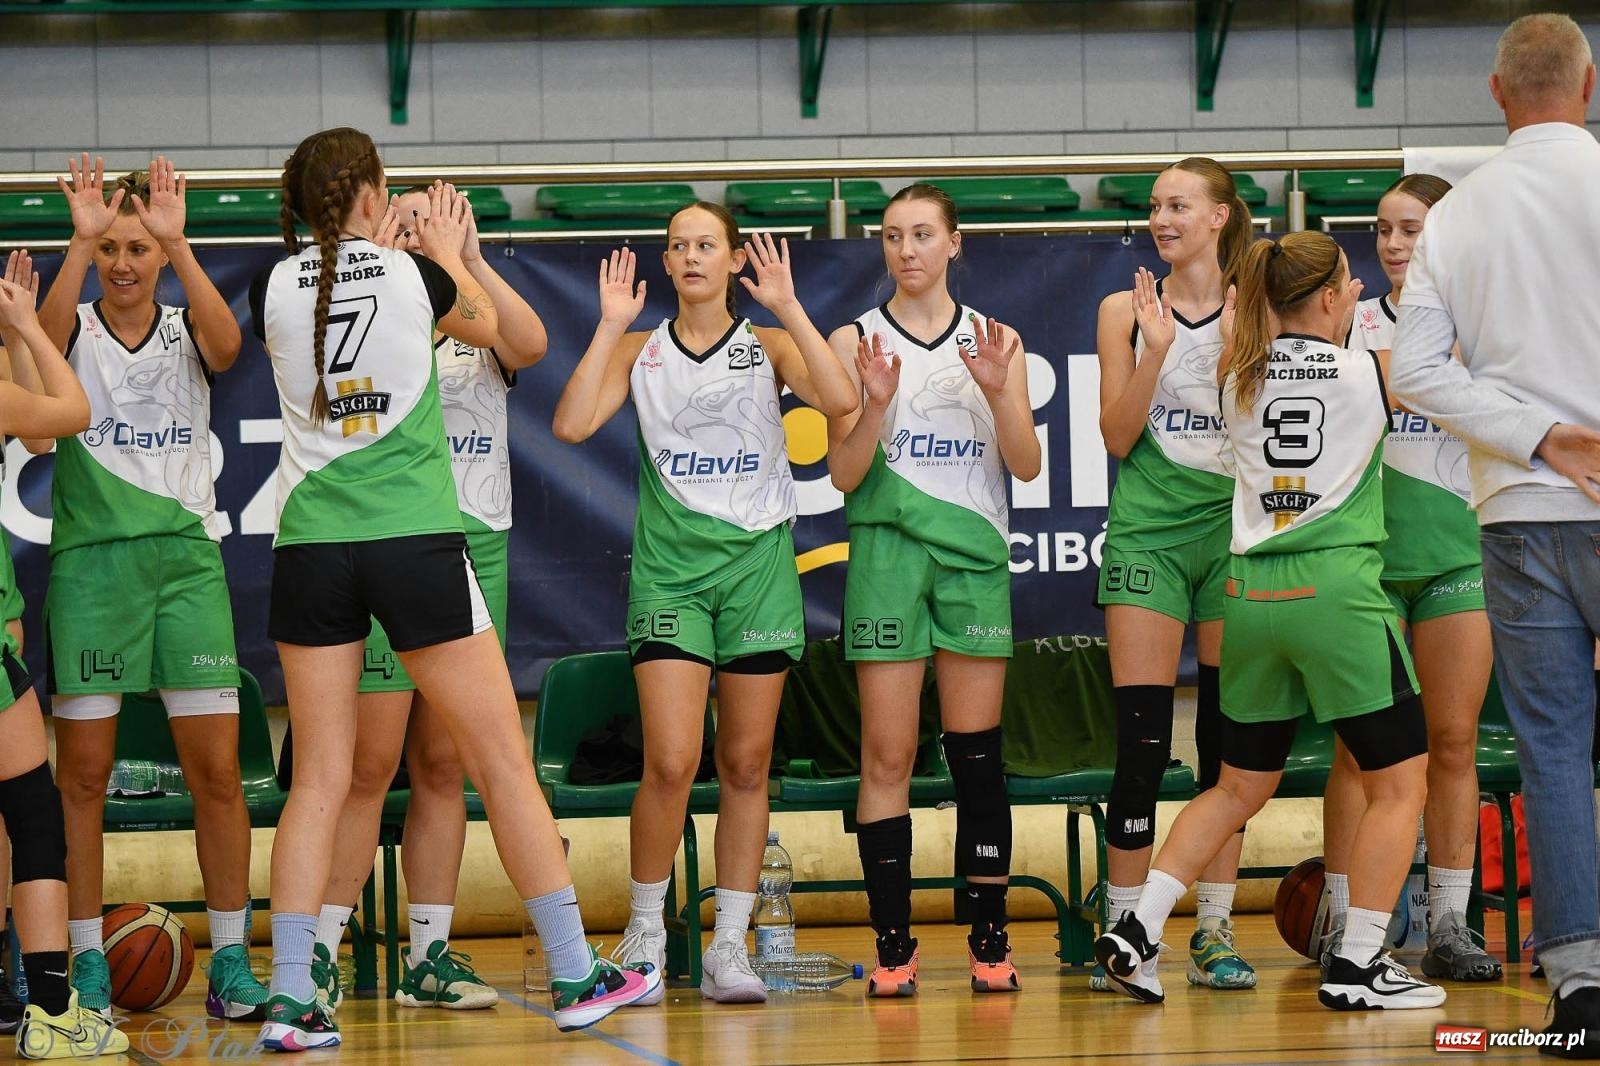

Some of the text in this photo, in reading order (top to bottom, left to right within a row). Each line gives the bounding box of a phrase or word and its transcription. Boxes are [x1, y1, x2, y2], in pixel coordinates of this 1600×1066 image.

[300, 252, 379, 272] RK AZS
[298, 265, 385, 288] RAIBÓRZ
[328, 295, 378, 374] 7
[1264, 364, 1339, 380] ACIBÓRZ
[330, 396, 386, 417] SEGET
[113, 420, 192, 449] Clavis
[446, 430, 492, 454] vis
[1263, 396, 1326, 468] 3
[670, 449, 760, 476] Clavis
[1264, 494, 1316, 509] SEGET
[1008, 520, 1108, 575] CIB
[1106, 560, 1156, 595] 30
[631, 608, 680, 640] 26
[852, 617, 904, 649] 28
[81, 649, 125, 682] 14
[360, 647, 395, 680] 4
[1132, 817, 1149, 833] NBA
[982, 845, 999, 858] NBA
